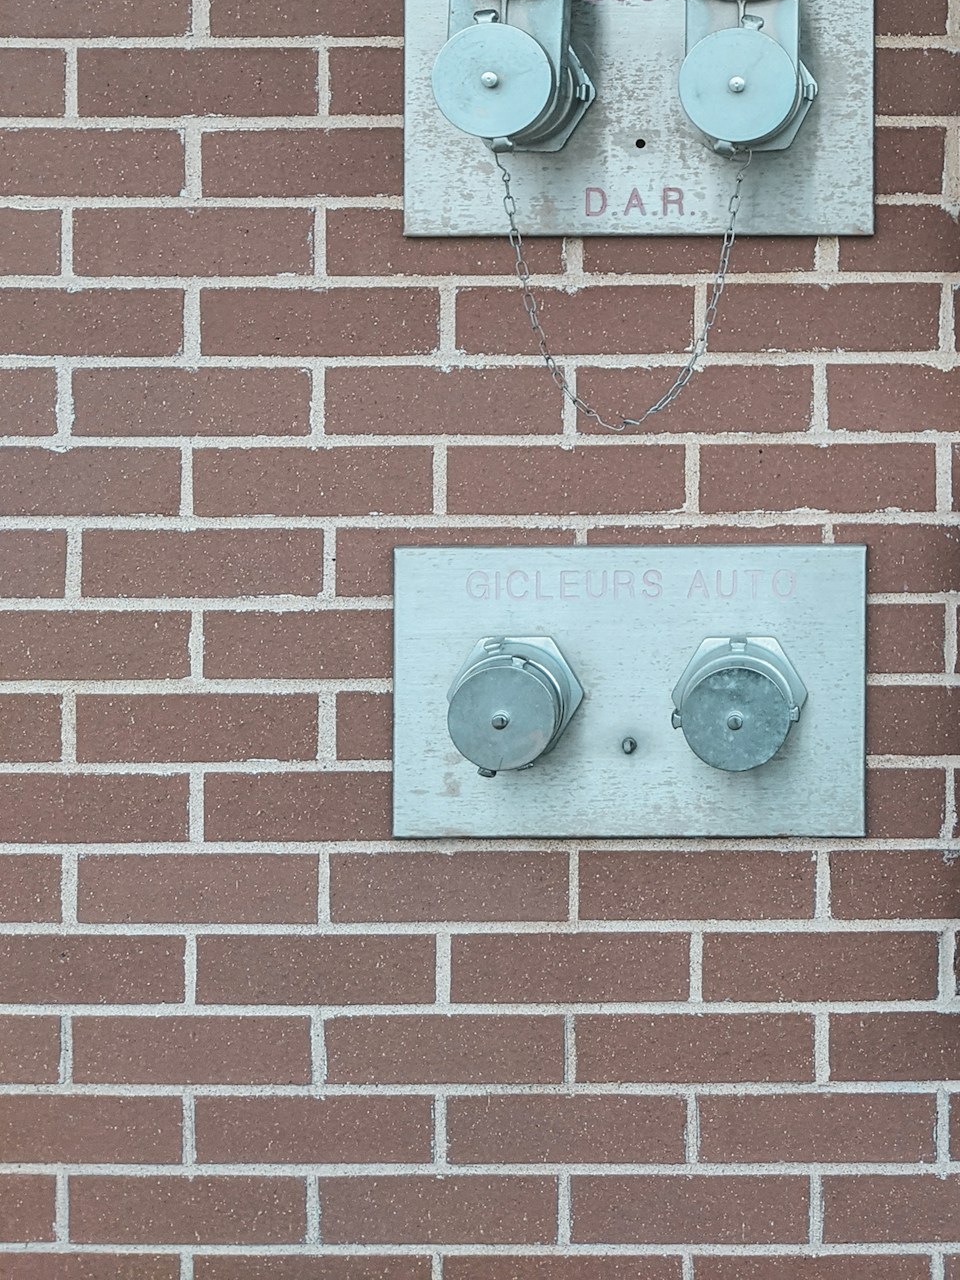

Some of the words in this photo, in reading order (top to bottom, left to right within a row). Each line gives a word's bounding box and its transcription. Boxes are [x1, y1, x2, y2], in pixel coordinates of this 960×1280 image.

[584, 186, 695, 217] D.A.R.
[465, 569, 664, 601] GICLEURS
[687, 569, 799, 599] AUTO
